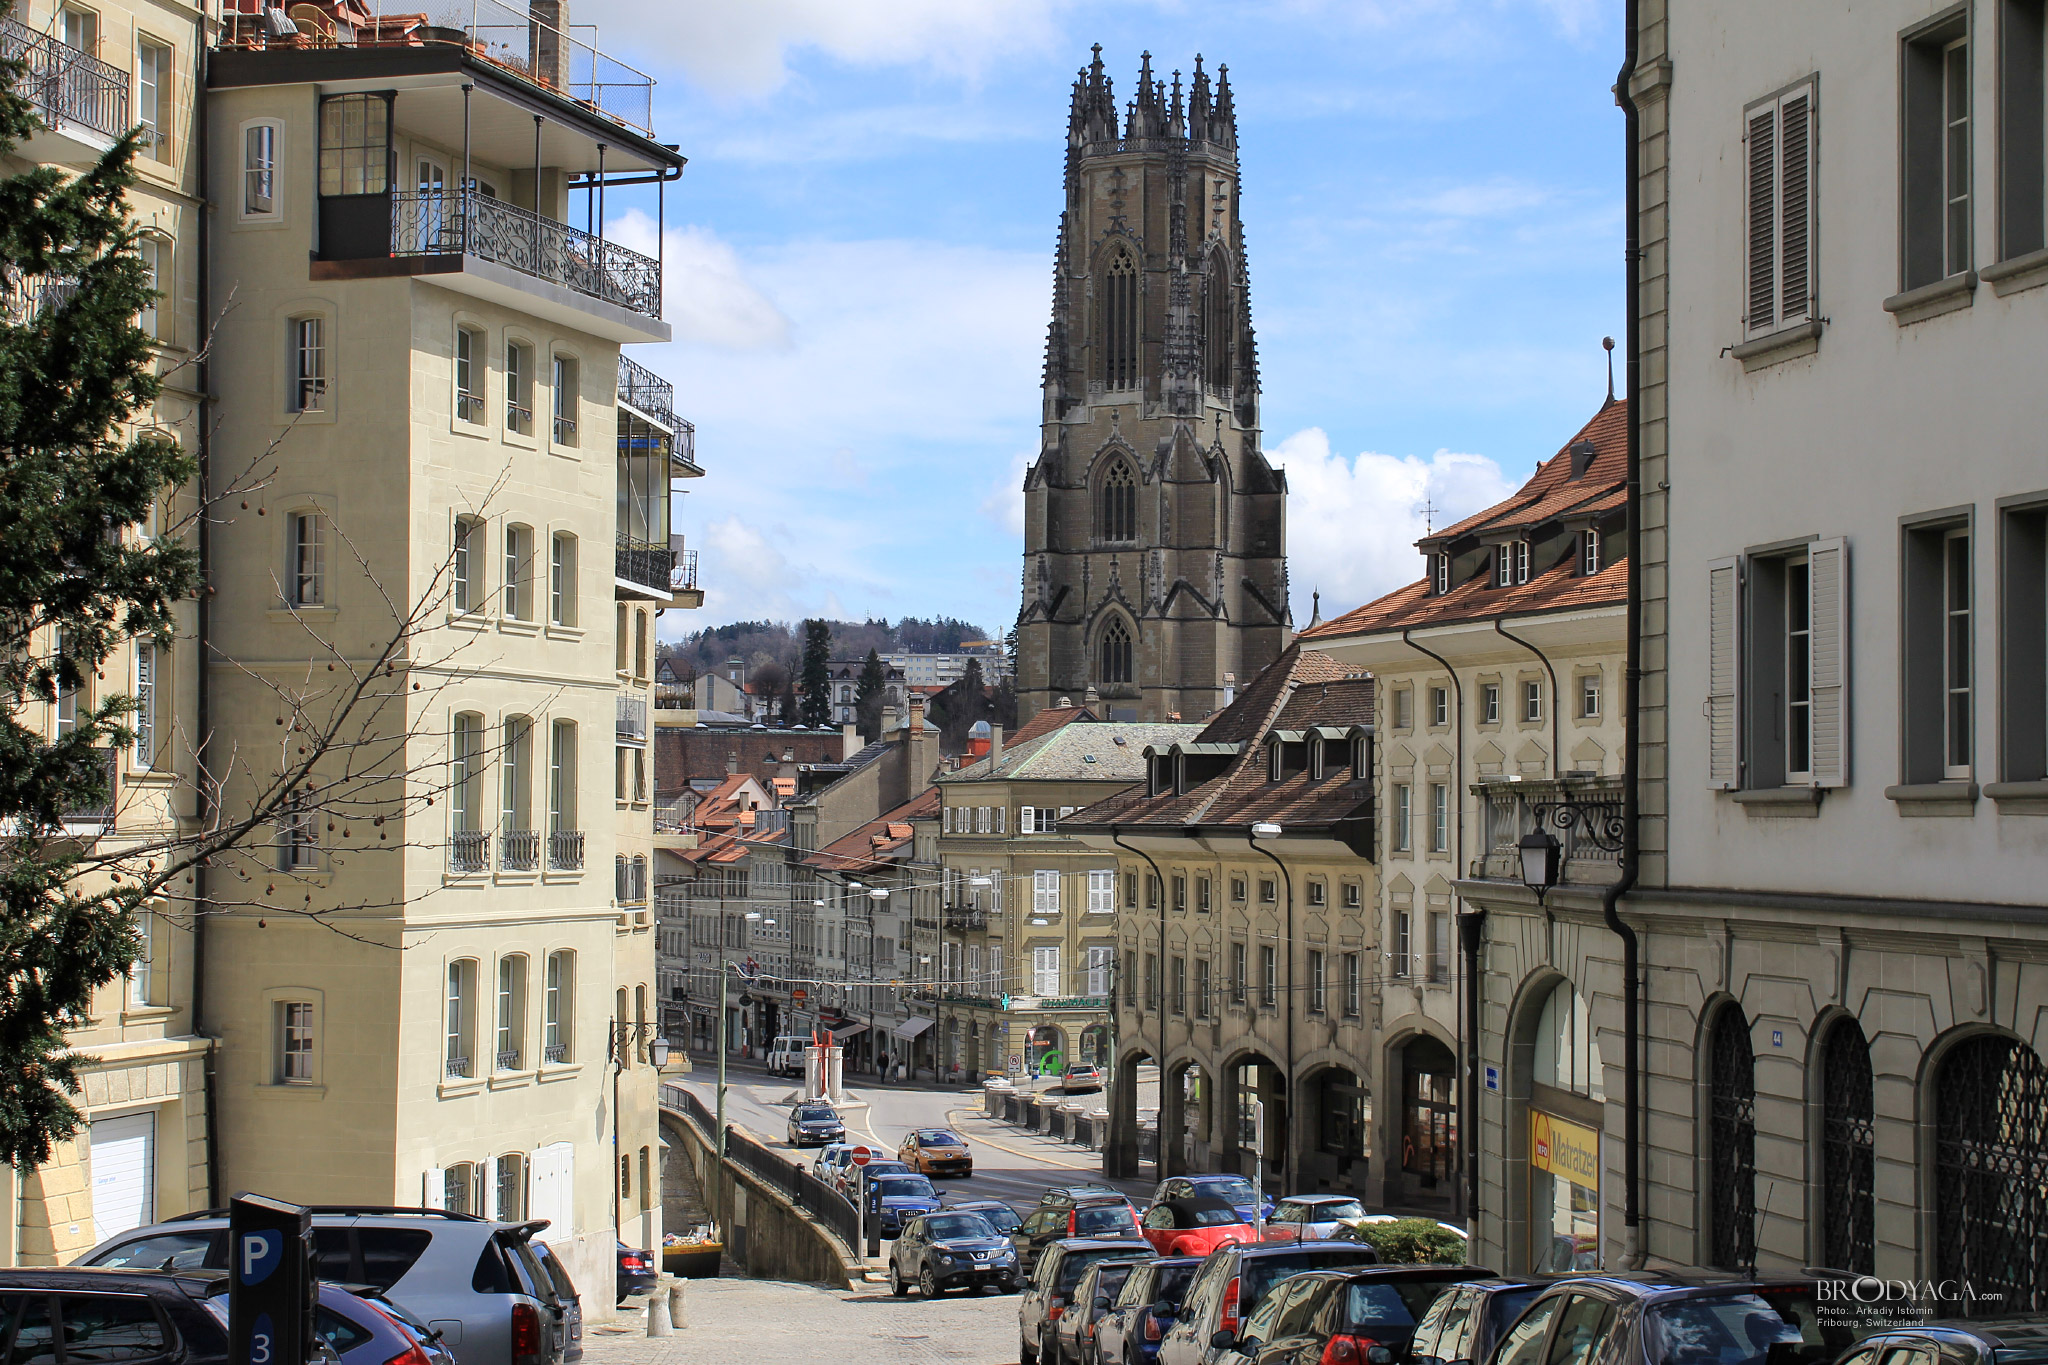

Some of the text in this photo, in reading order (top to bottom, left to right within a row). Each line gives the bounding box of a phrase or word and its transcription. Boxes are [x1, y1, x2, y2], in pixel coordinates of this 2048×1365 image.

[1773, 1032, 1781, 1044] 44
[870, 1183, 876, 1191] P
[244, 1236, 269, 1275] P
[252, 1333, 270, 1363] 3
